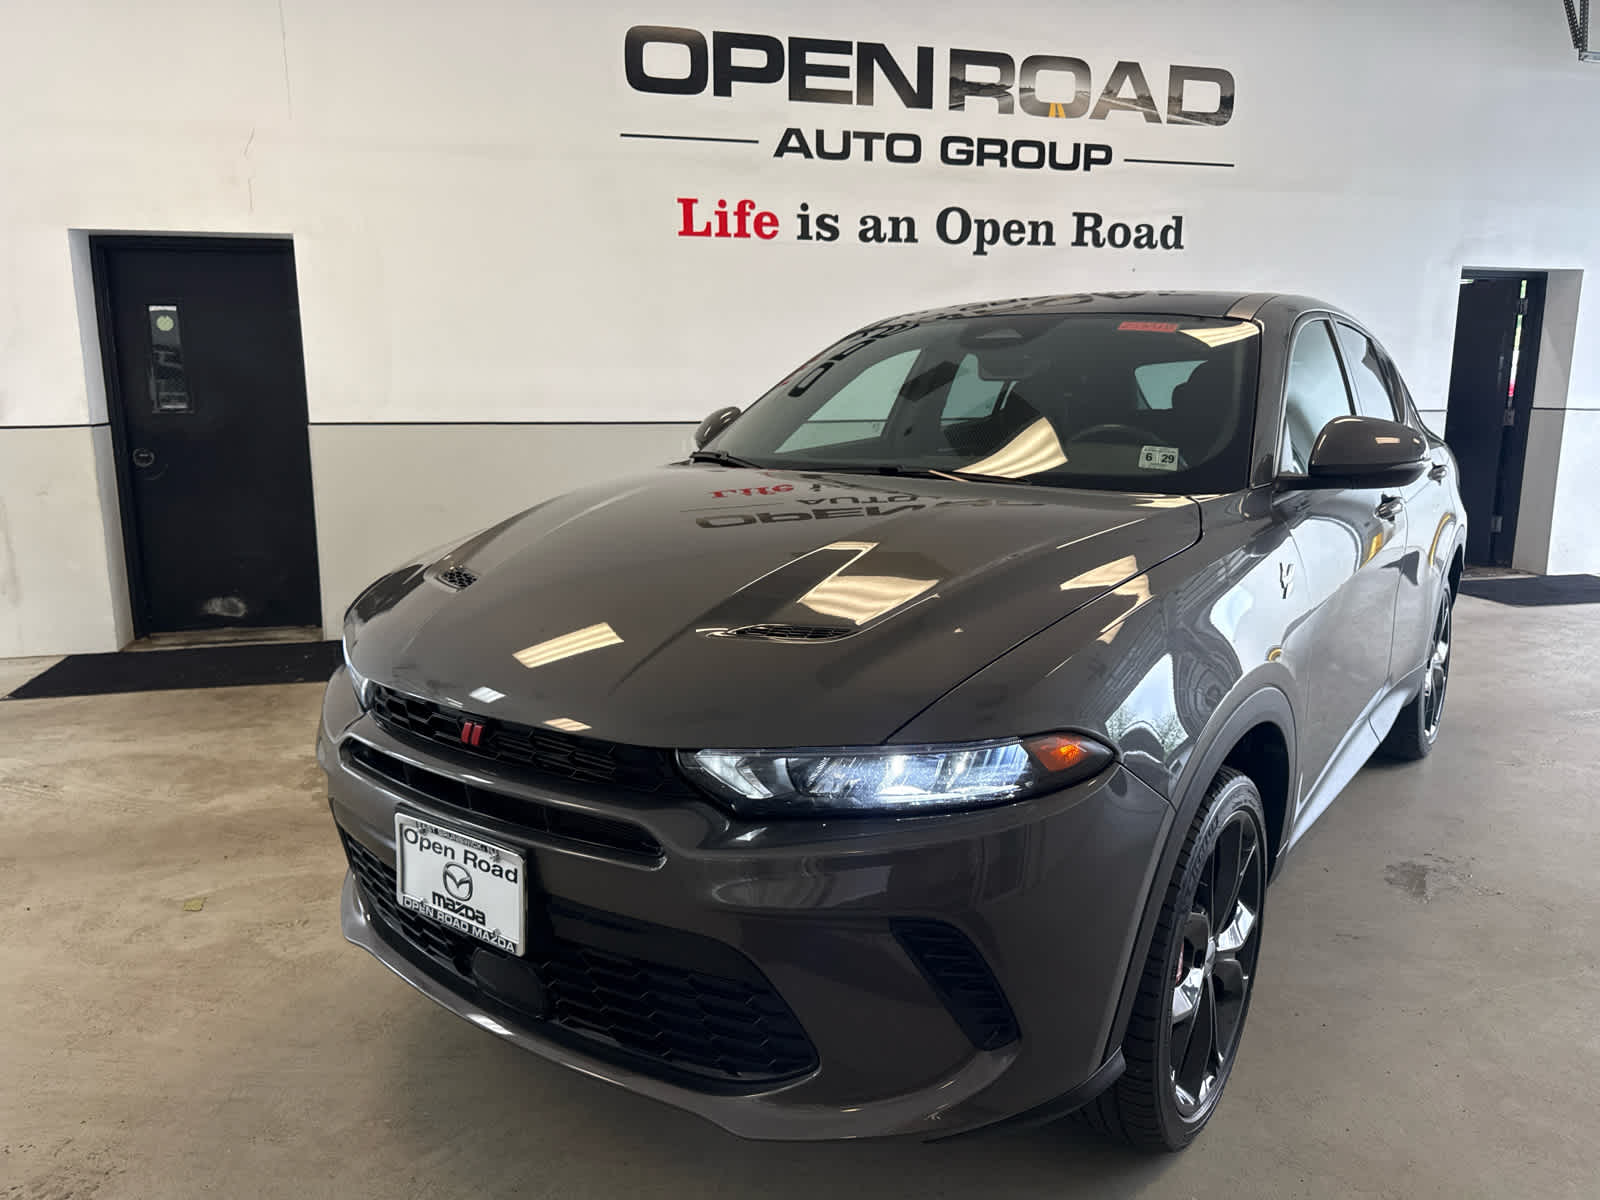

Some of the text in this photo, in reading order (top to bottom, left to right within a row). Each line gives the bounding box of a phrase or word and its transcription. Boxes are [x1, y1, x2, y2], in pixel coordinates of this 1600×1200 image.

[625, 25, 1235, 127] OPEN ROAD
[773, 127, 1113, 172] AUTO GROUP
[676, 197, 1185, 257] Life is an Open Road
[1161, 454, 1175, 464] 29
[403, 828, 456, 859] Open
[463, 849, 518, 884] Road
[403, 897, 517, 953] OPEN ROAD MAZDA
